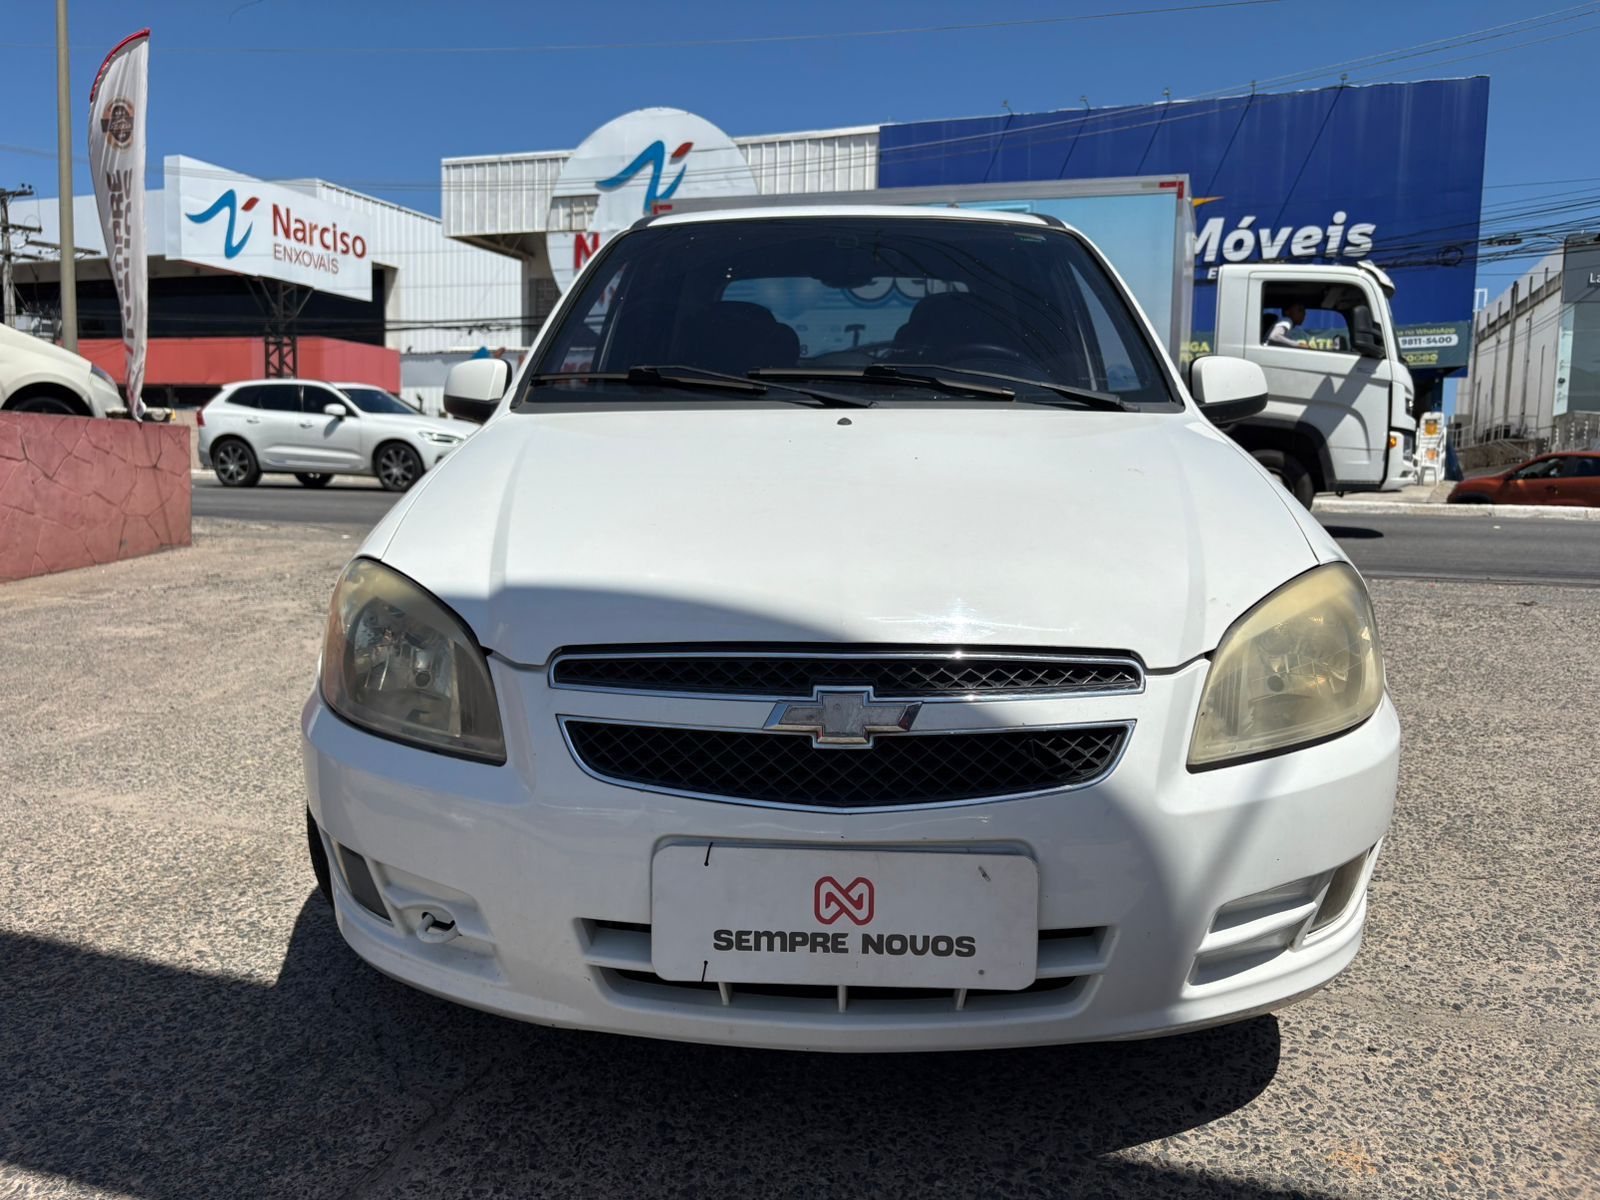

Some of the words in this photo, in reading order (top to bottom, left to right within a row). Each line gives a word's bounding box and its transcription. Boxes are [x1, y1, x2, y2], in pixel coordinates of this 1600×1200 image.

[272, 203, 367, 260] Narciso
[1194, 211, 1376, 263] Móveis
[273, 243, 340, 275] ENXOVAIS
[713, 929, 849, 954] SEMPRE
[861, 933, 976, 957] NOVOS
